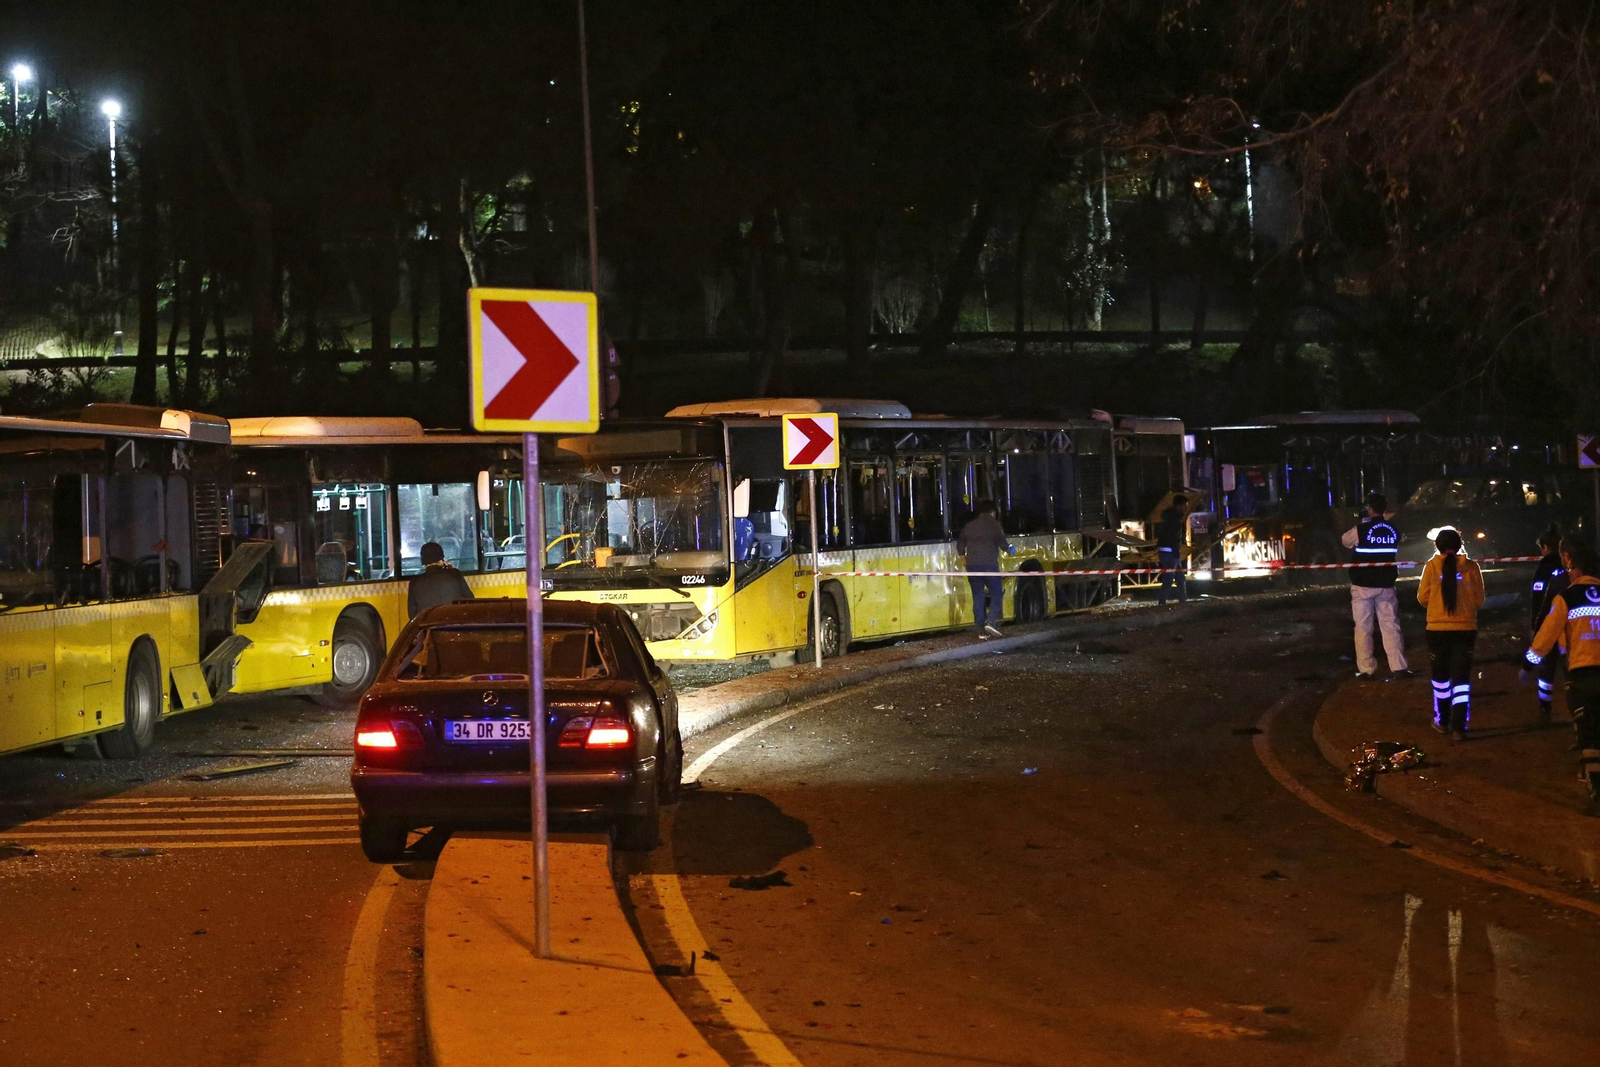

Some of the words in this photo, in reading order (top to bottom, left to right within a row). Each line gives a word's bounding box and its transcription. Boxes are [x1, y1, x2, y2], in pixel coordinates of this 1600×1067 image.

[1370, 535, 1395, 544] POLİS
[1254, 540, 1286, 561] SENİN
[681, 575, 706, 584] 02246
[454, 723, 470, 738] 34
[477, 723, 494, 738] DR
